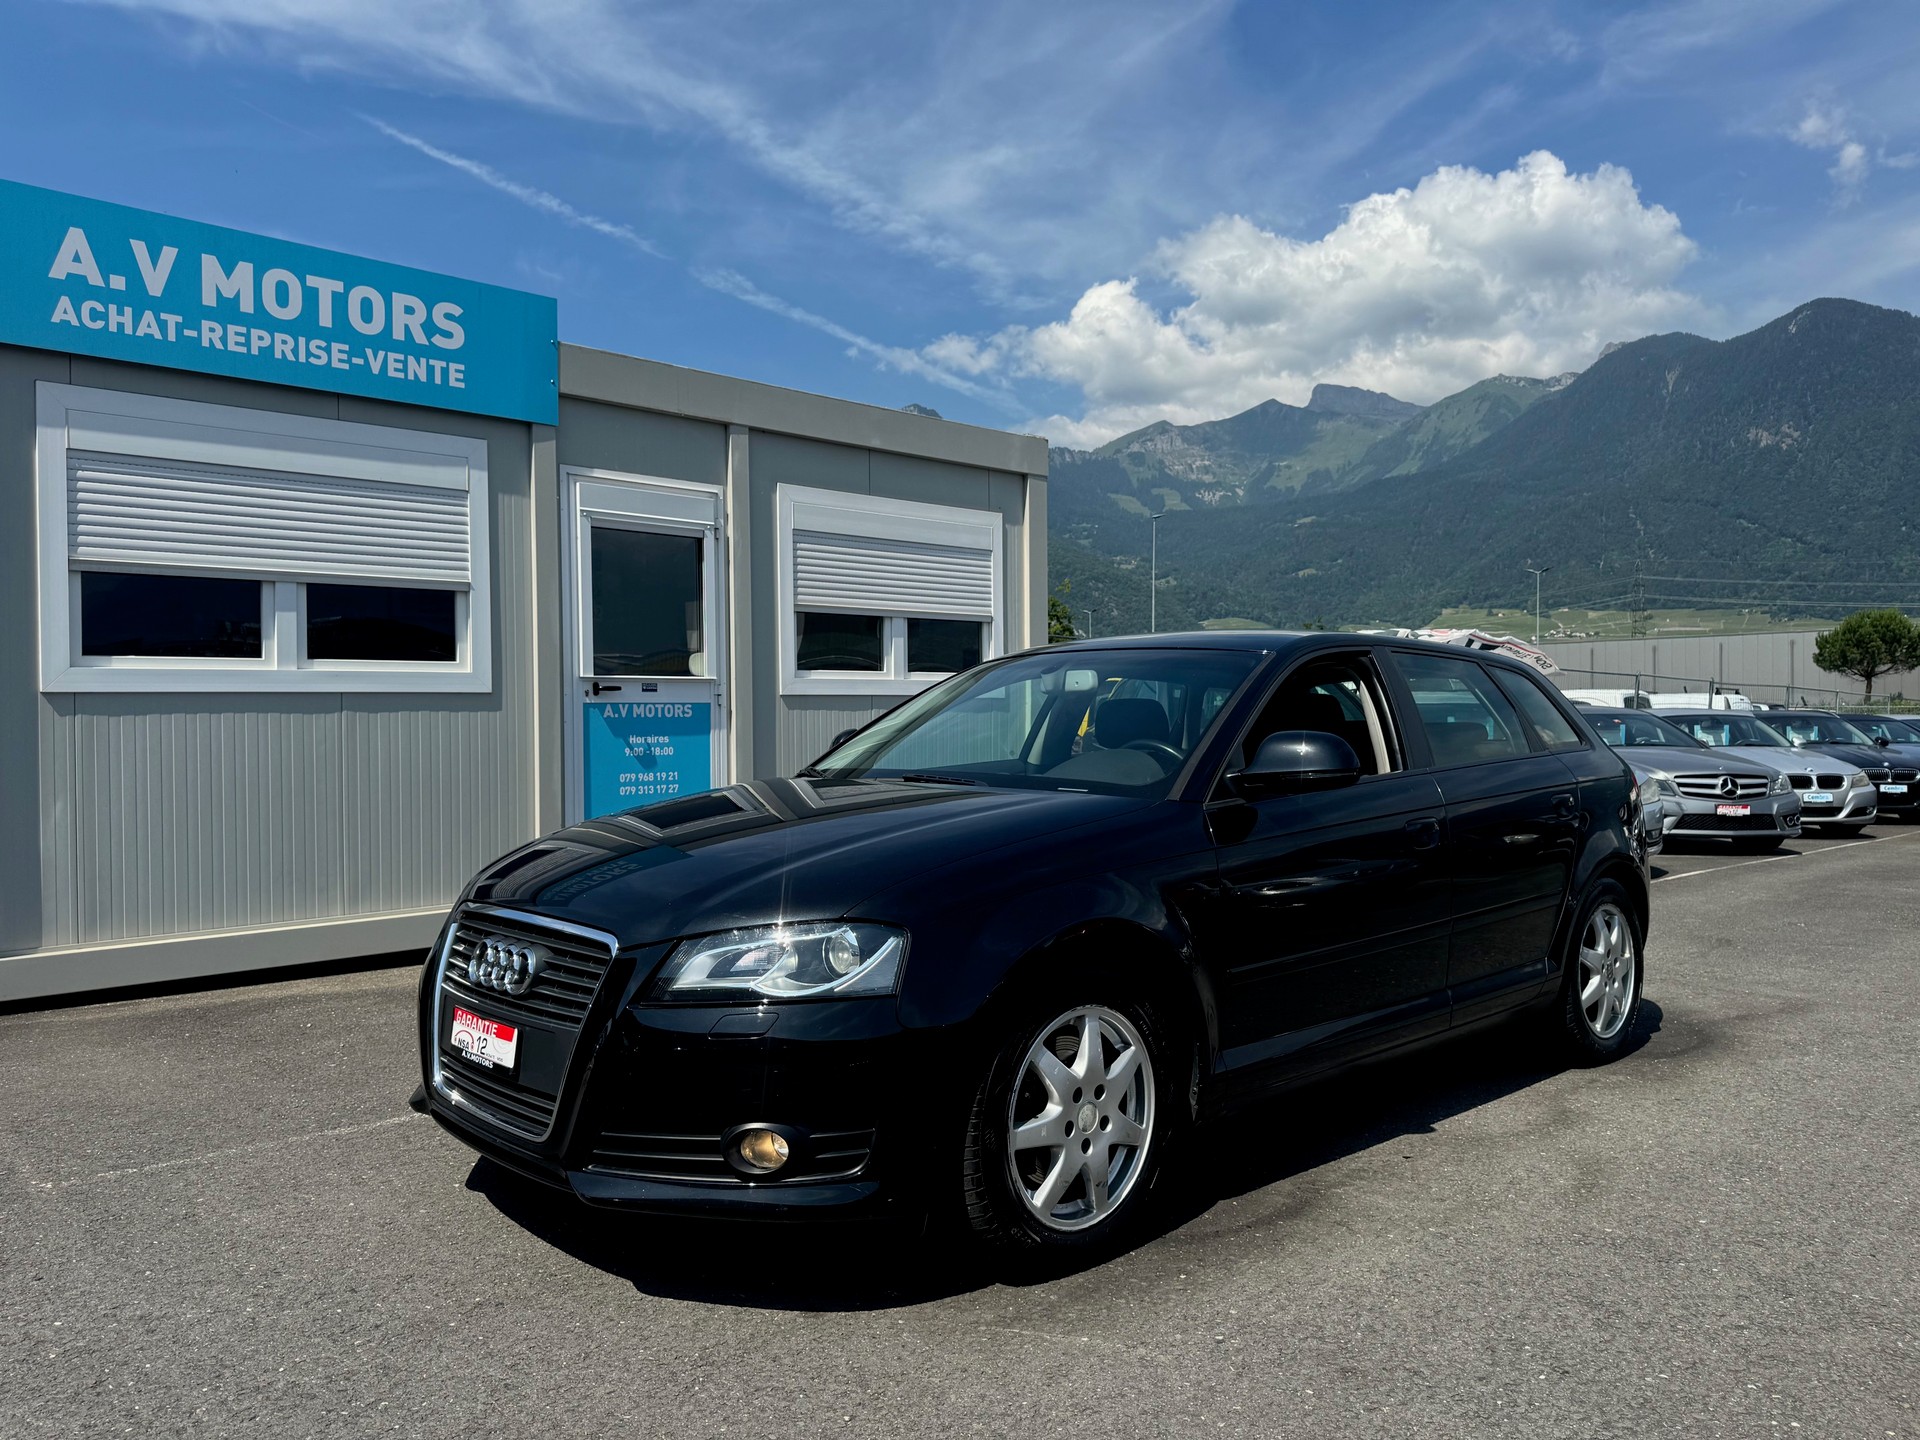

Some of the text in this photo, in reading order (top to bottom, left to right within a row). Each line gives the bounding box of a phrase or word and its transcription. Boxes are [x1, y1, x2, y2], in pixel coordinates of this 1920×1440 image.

[48, 226, 465, 350] A.V MOTORS
[50, 295, 466, 389] ACHAT-REPRISE-VENTE
[603, 704, 693, 718] A.V MOTORS
[629, 734, 670, 744] Horaires
[624, 747, 644, 757] 9:00
[619, 771, 679, 783] 079 968 19 21
[619, 784, 679, 795] 079 313 17 27
[456, 1010, 498, 1038] GARANTIE
[457, 1038, 470, 1050] NSA
[476, 1035, 488, 1056] 12
